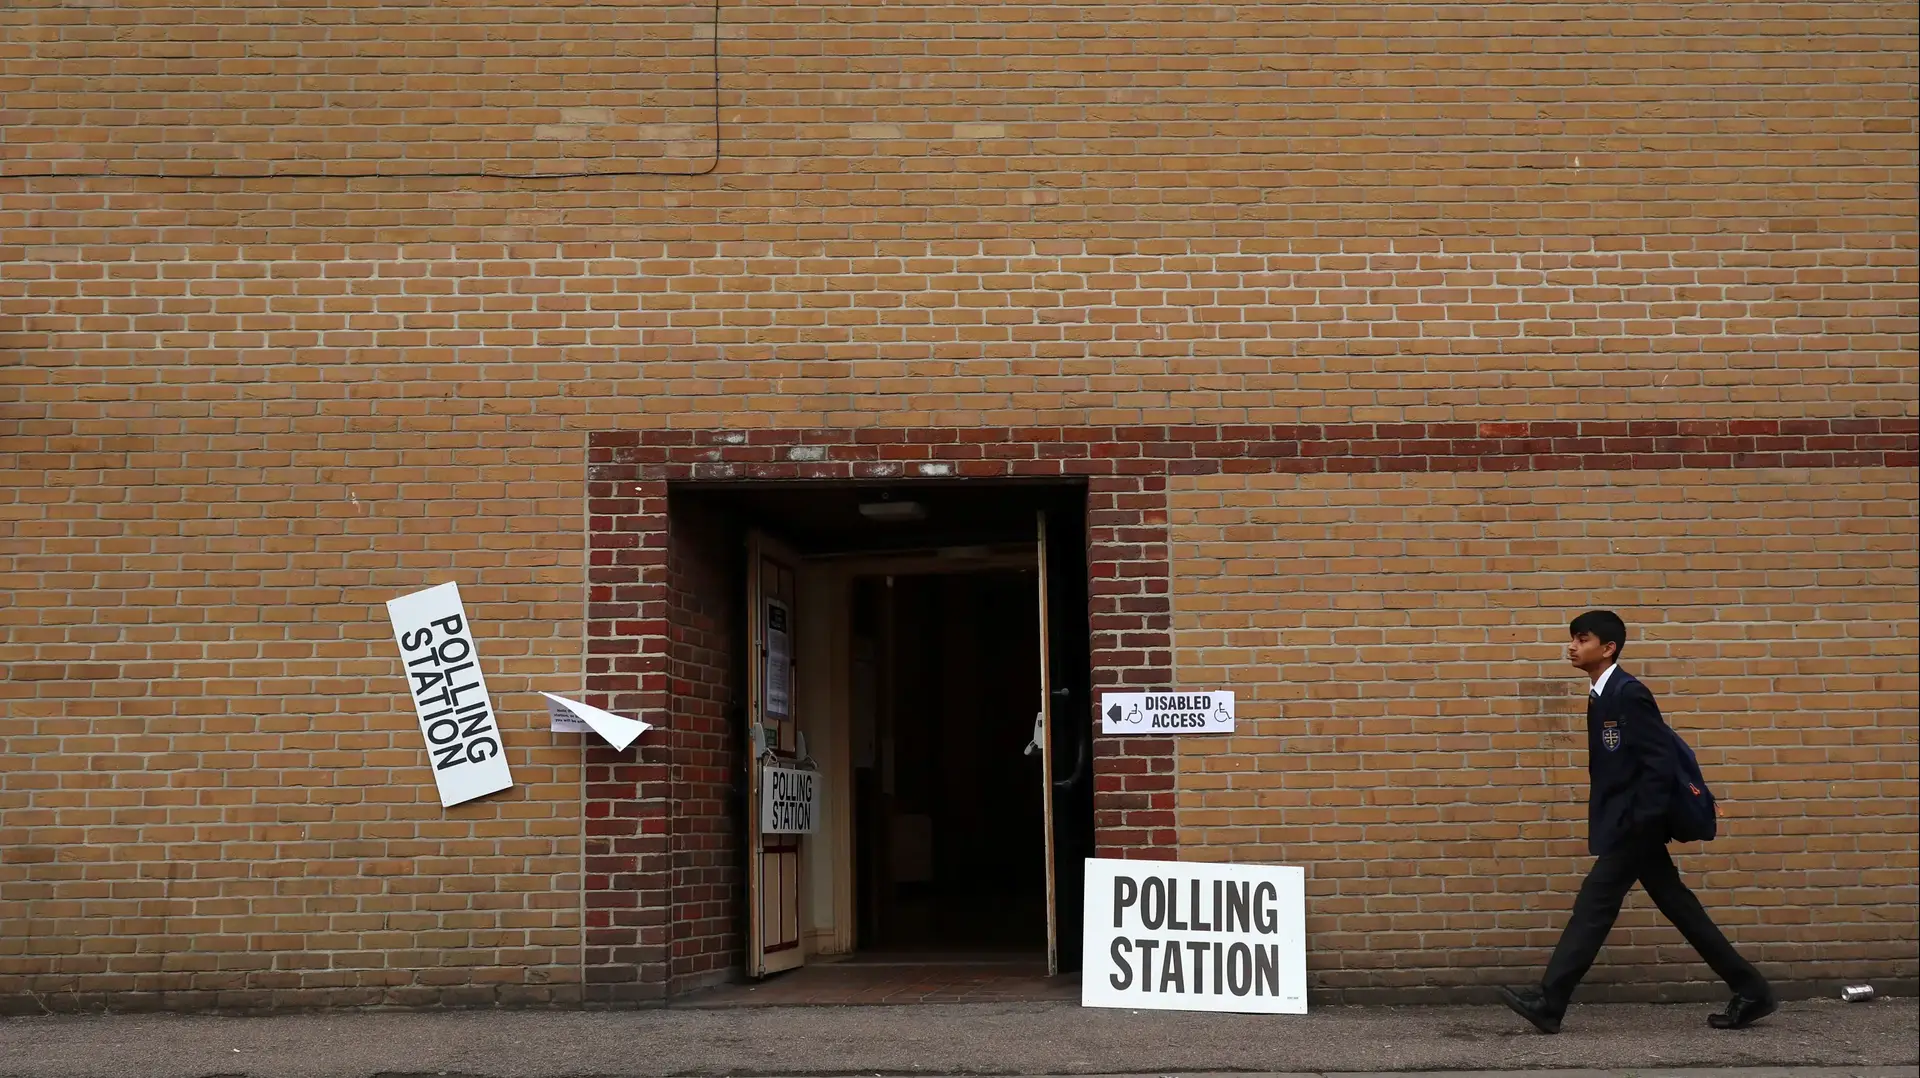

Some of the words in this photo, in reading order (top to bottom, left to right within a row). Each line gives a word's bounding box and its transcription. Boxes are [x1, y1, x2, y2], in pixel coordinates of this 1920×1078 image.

[401, 627, 467, 771] STATION
[430, 613, 498, 764] POLLING
[1145, 695, 1212, 711] DISABLED
[1151, 713, 1206, 728] ACCESS
[773, 772, 812, 802] POLLING
[772, 801, 811, 830] STATION
[1113, 876, 1278, 934] POLLING
[1109, 936, 1279, 996] STATION
